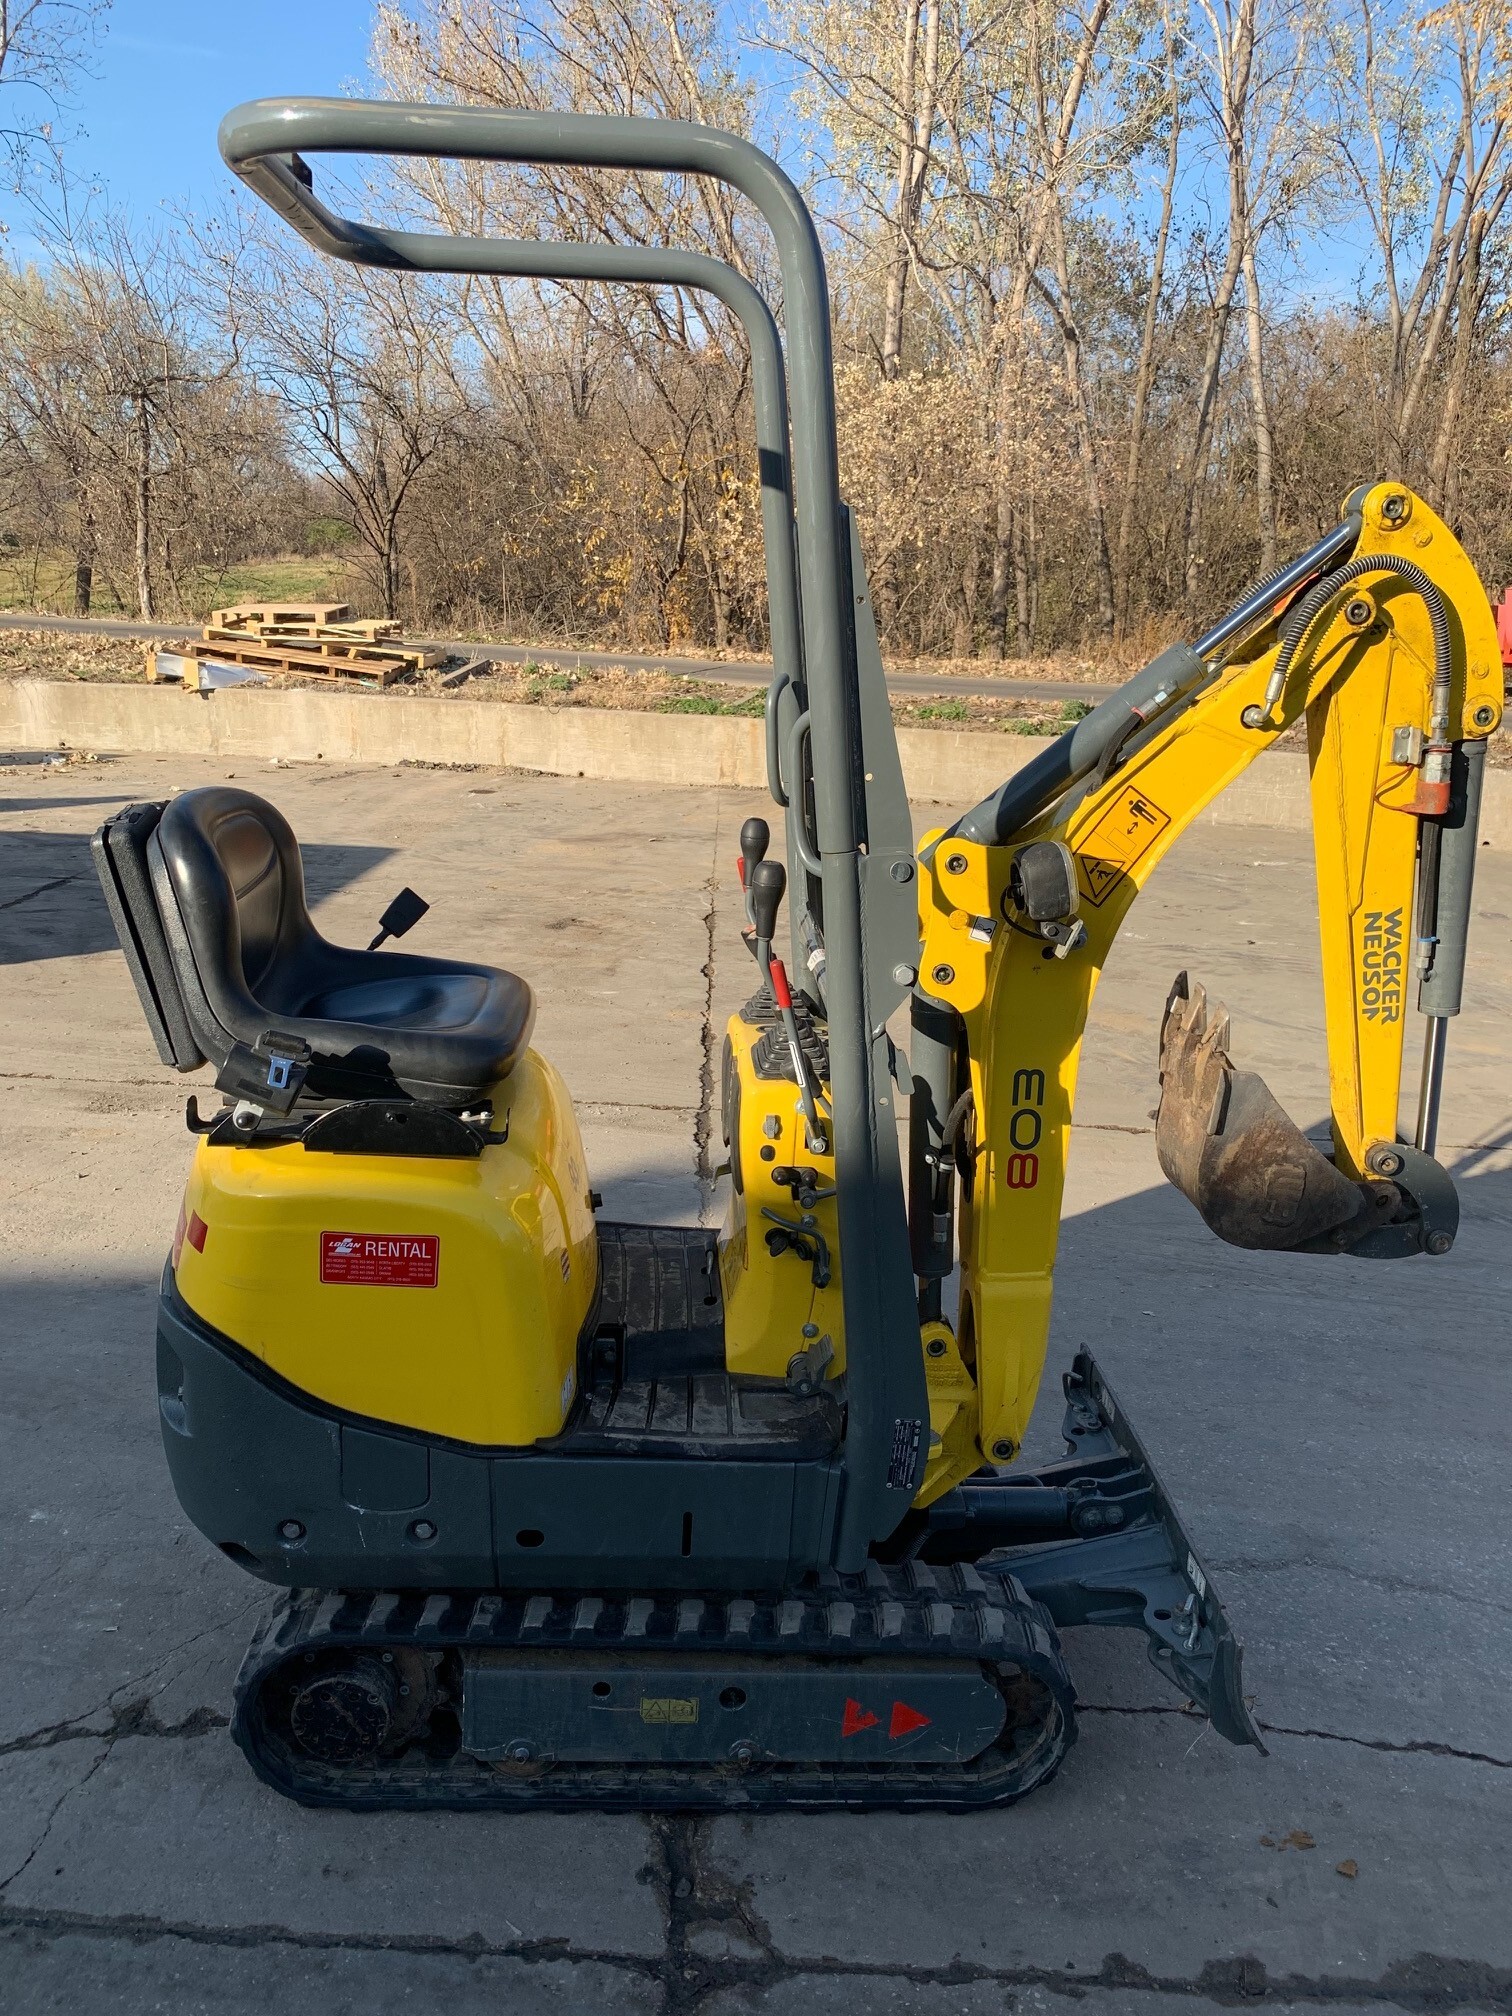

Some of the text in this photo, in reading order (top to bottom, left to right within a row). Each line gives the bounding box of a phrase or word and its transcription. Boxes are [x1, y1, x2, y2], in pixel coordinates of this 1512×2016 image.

[1361, 911, 1383, 1022] NEUSON
[1381, 906, 1403, 1026] WACKER
[1006, 1068, 1046, 1190] 803
[365, 1241, 432, 1259] RENTAL
